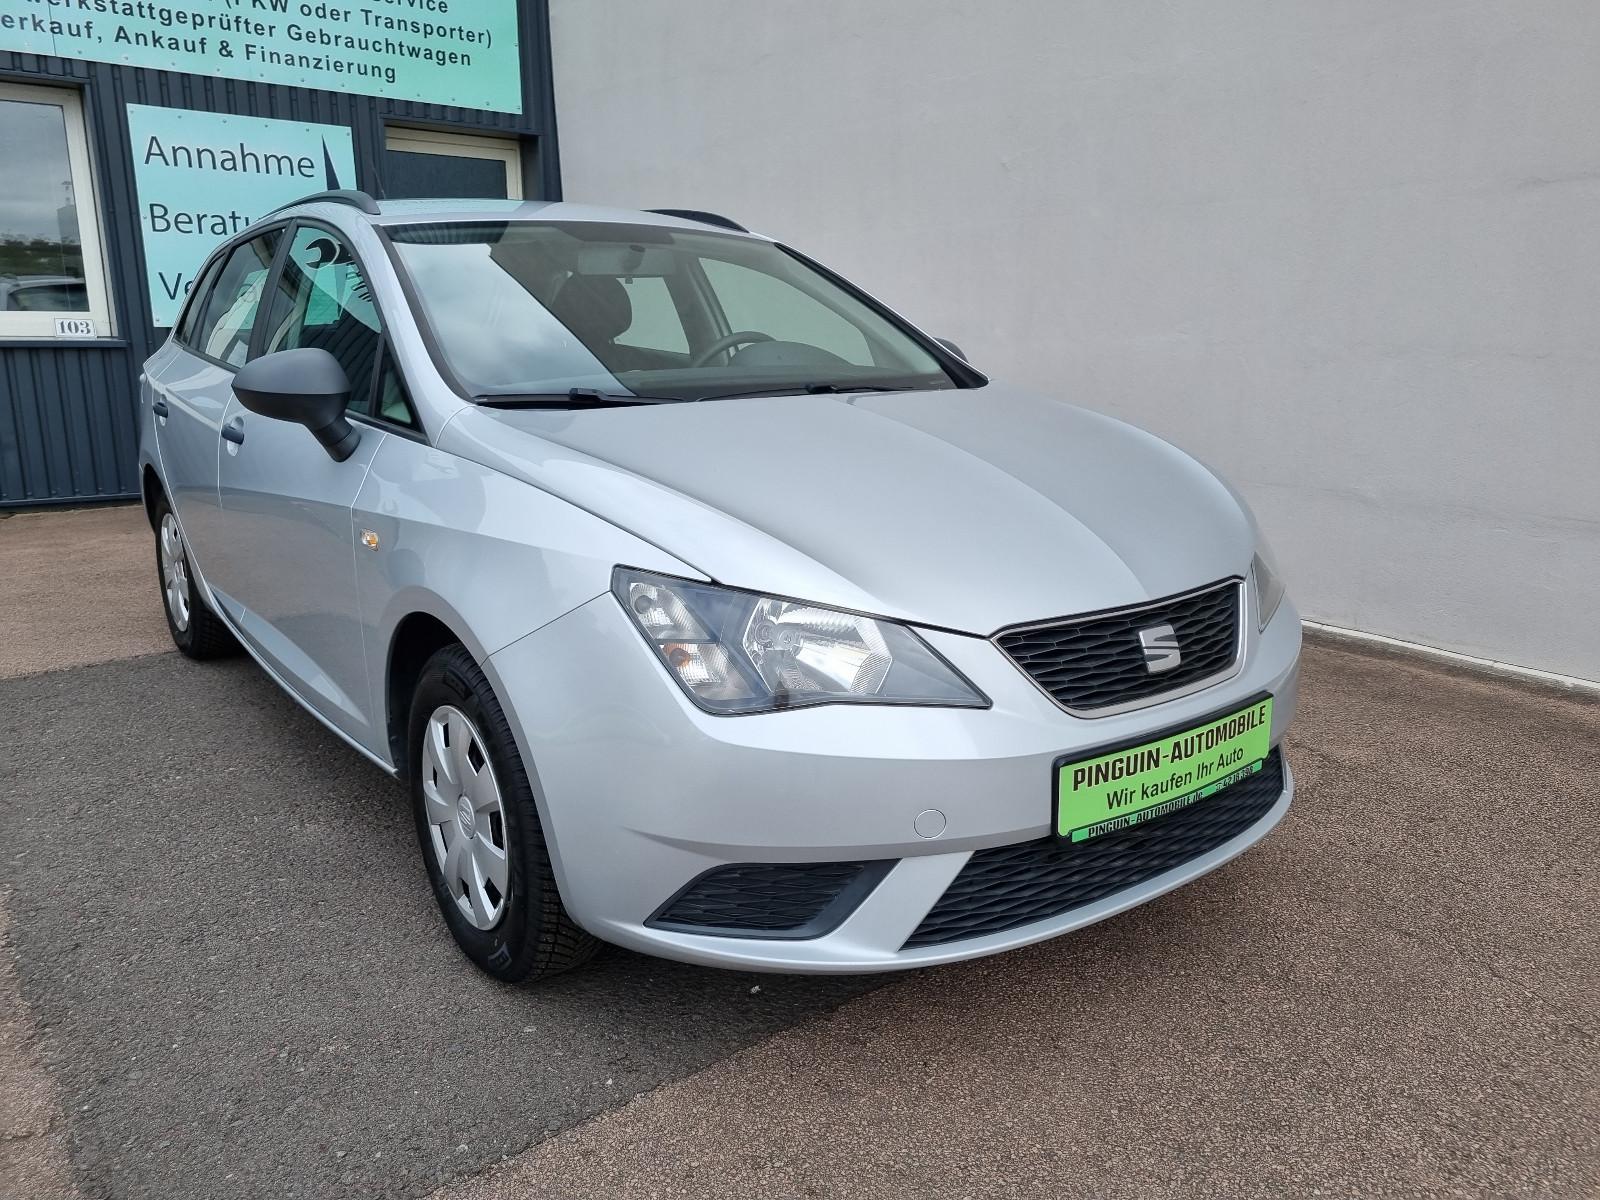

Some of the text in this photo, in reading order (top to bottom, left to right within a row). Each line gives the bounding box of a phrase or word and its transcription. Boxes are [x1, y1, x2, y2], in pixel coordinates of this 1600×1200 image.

[300, 3, 352, 23] oder
[360, 9, 493, 48] Transporter)
[373, 0, 449, 14] rvice
[27, 0, 472, 67] erkstattgeprüfter Gebrauchtwagen
[114, 25, 208, 54] Ankauf
[218, 40, 235, 58] &
[245, 43, 397, 83] Finanzierung
[144, 136, 316, 178] Annahme
[149, 203, 260, 236] Berat
[60, 320, 91, 335] 103
[1073, 704, 1266, 791] PINGUIN-AUTOMOBILE
[1106, 746, 1244, 810] Wir kaufen Ihr Auto
